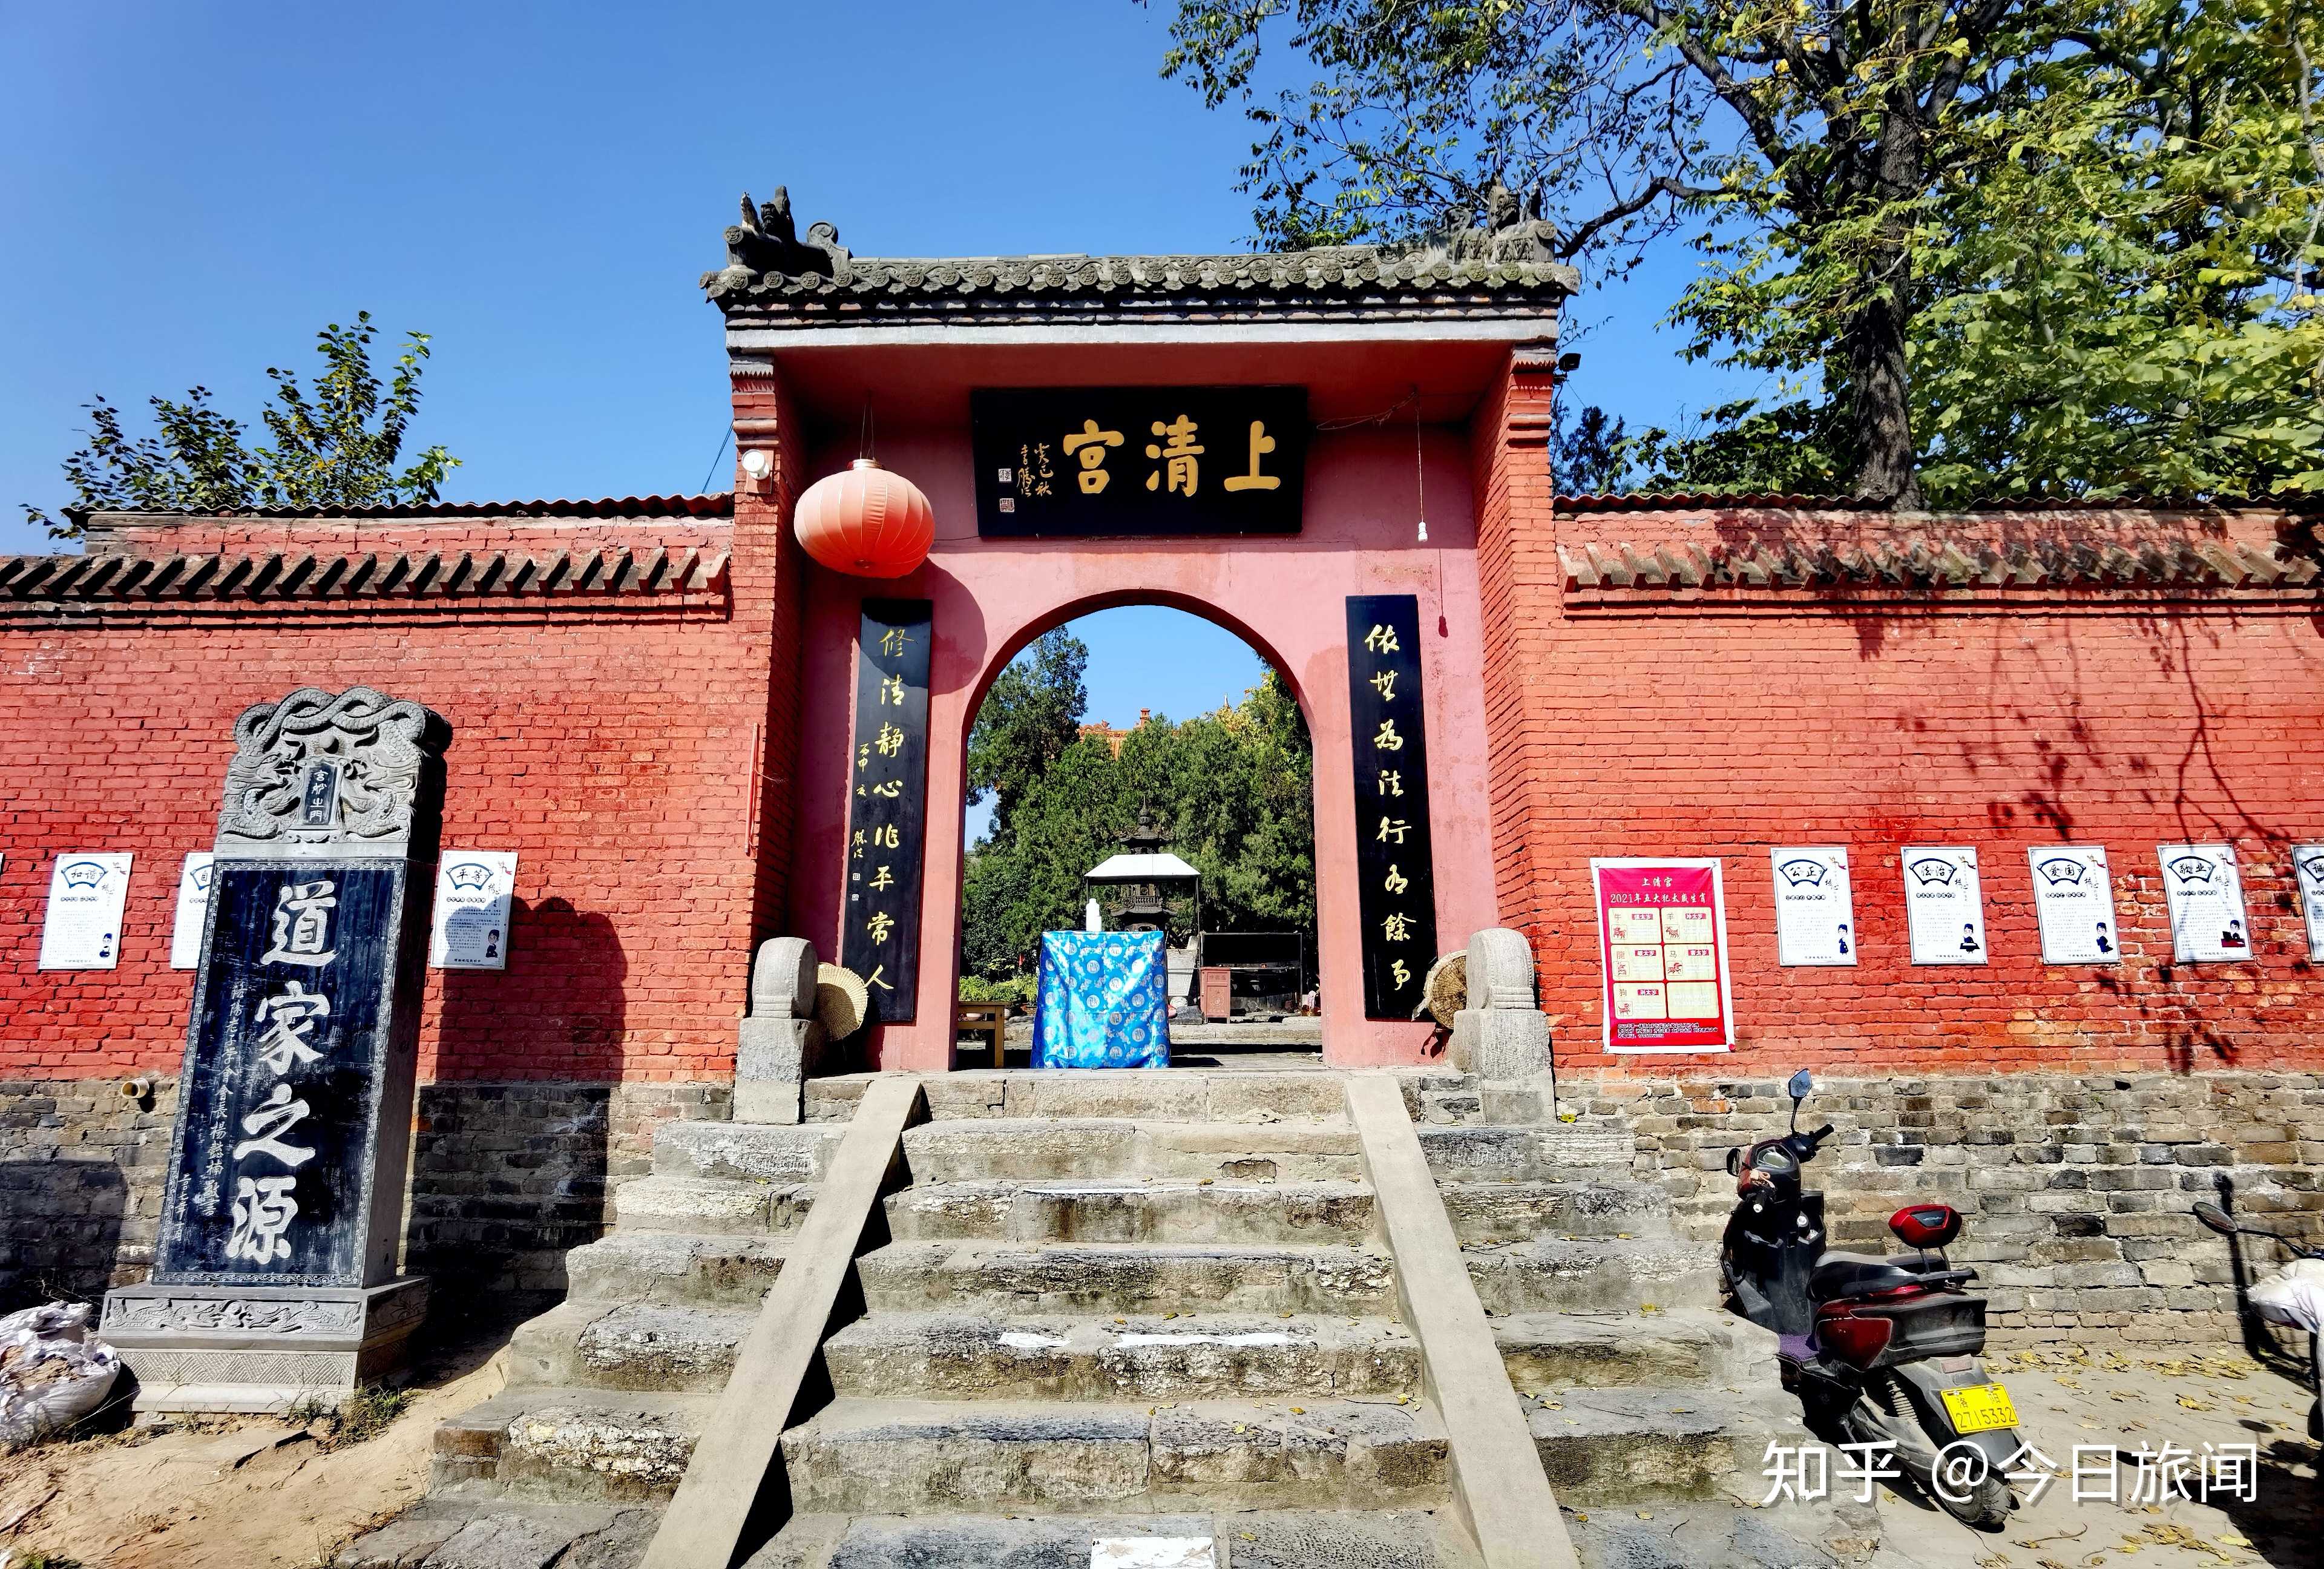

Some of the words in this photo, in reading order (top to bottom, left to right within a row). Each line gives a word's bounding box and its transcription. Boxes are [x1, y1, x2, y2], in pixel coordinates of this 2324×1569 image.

[1790, 866, 1817, 877] 公正
[1921, 864, 1945, 877] 法治
[2049, 864, 2075, 877] 爱国
[2179, 863, 2207, 875] 敬业
[456, 868, 482, 884] 平等
[225, 880, 340, 1265] 道家之源
[1955, 1407, 2015, 1428] 2715332
